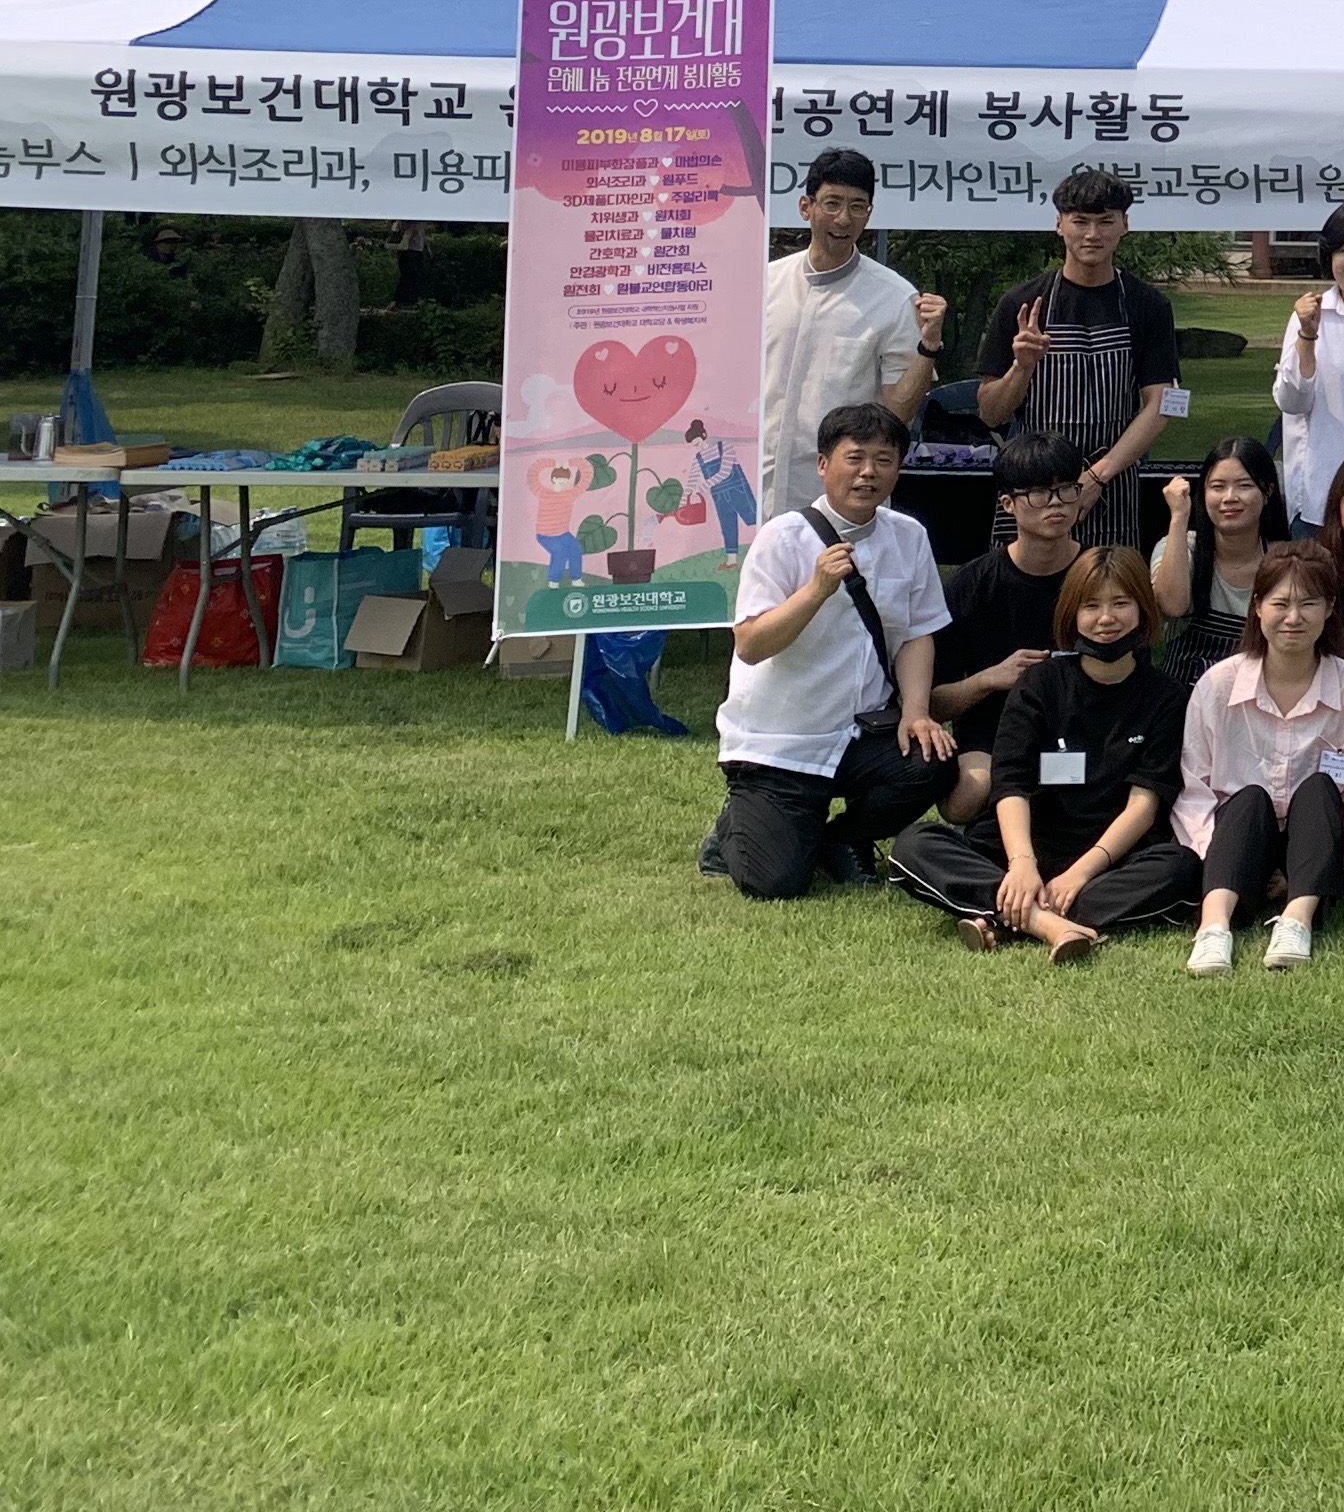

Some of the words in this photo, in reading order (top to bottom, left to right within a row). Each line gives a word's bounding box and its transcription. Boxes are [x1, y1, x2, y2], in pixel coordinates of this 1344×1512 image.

[547, 65, 610, 92] 은혜나눔
[616, 64, 678, 91] 전공연계
[683, 62, 743, 89] 봉사활동
[91, 67, 473, 126] 원광보건대학교
[977, 89, 1190, 143] 봉사활동
[159, 142, 371, 193] 외식조리과,
[393, 148, 511, 194] 미용피
[586, 175, 646, 189] 외식조리과
[590, 211, 639, 224] 치위생과
[589, 246, 638, 261] 간호학과
[592, 591, 687, 608] 원광보건대학교
